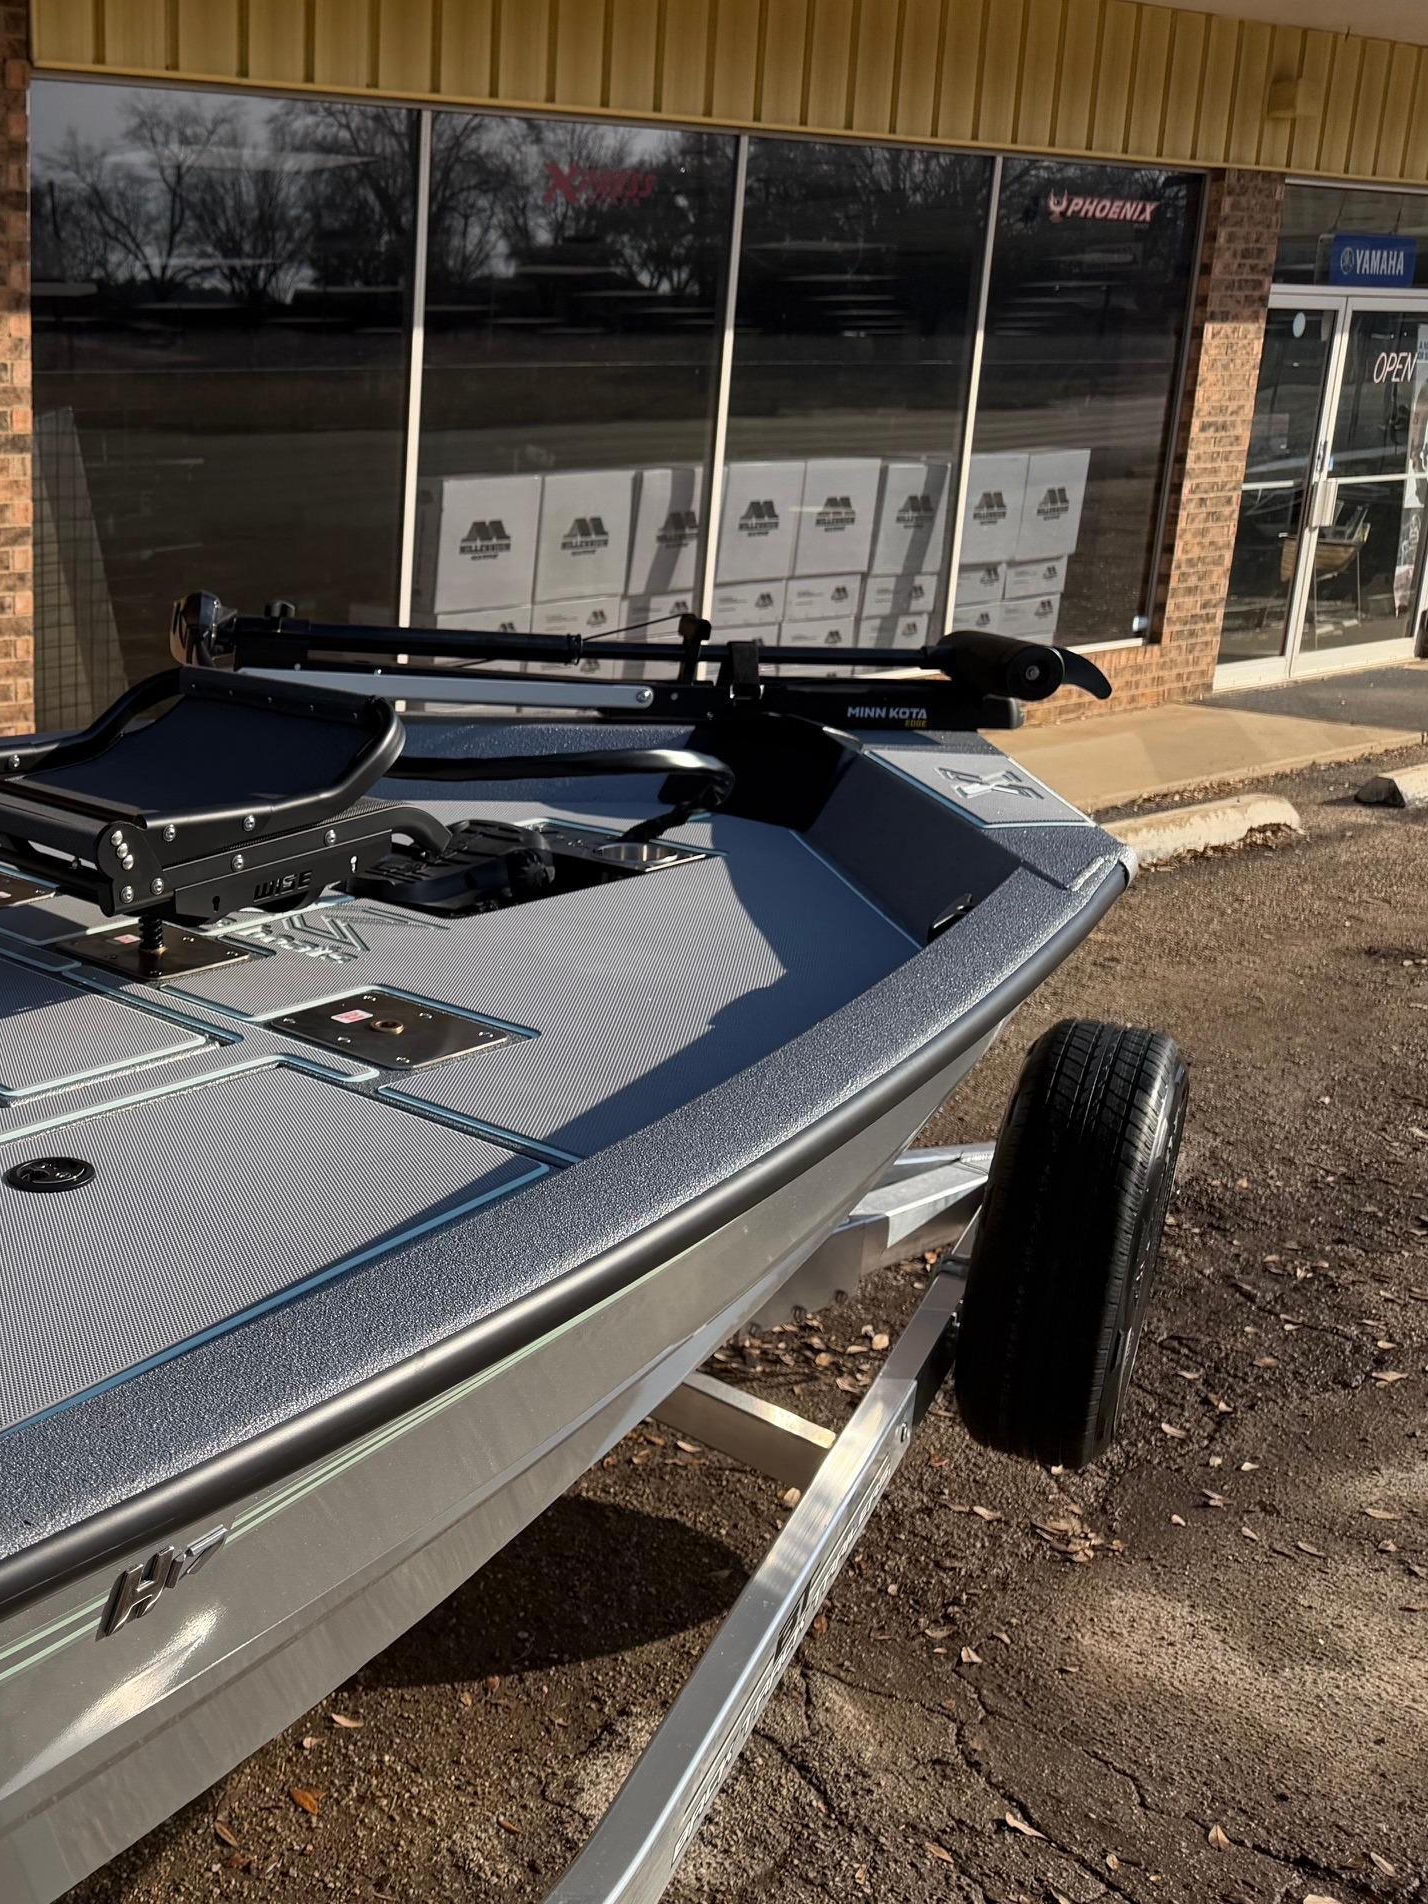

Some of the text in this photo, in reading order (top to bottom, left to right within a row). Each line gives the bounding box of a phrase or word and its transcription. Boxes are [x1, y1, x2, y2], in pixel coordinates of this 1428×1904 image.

[1066, 196, 1160, 222] PHOENIX
[1355, 249, 1404, 276] YAMAHA
[1373, 351, 1419, 384] OPEN
[847, 706, 928, 719] MINN KOTA
[253, 869, 312, 903] WISE
[671, 1462, 892, 1867] BACK TRACK TRAILERS
